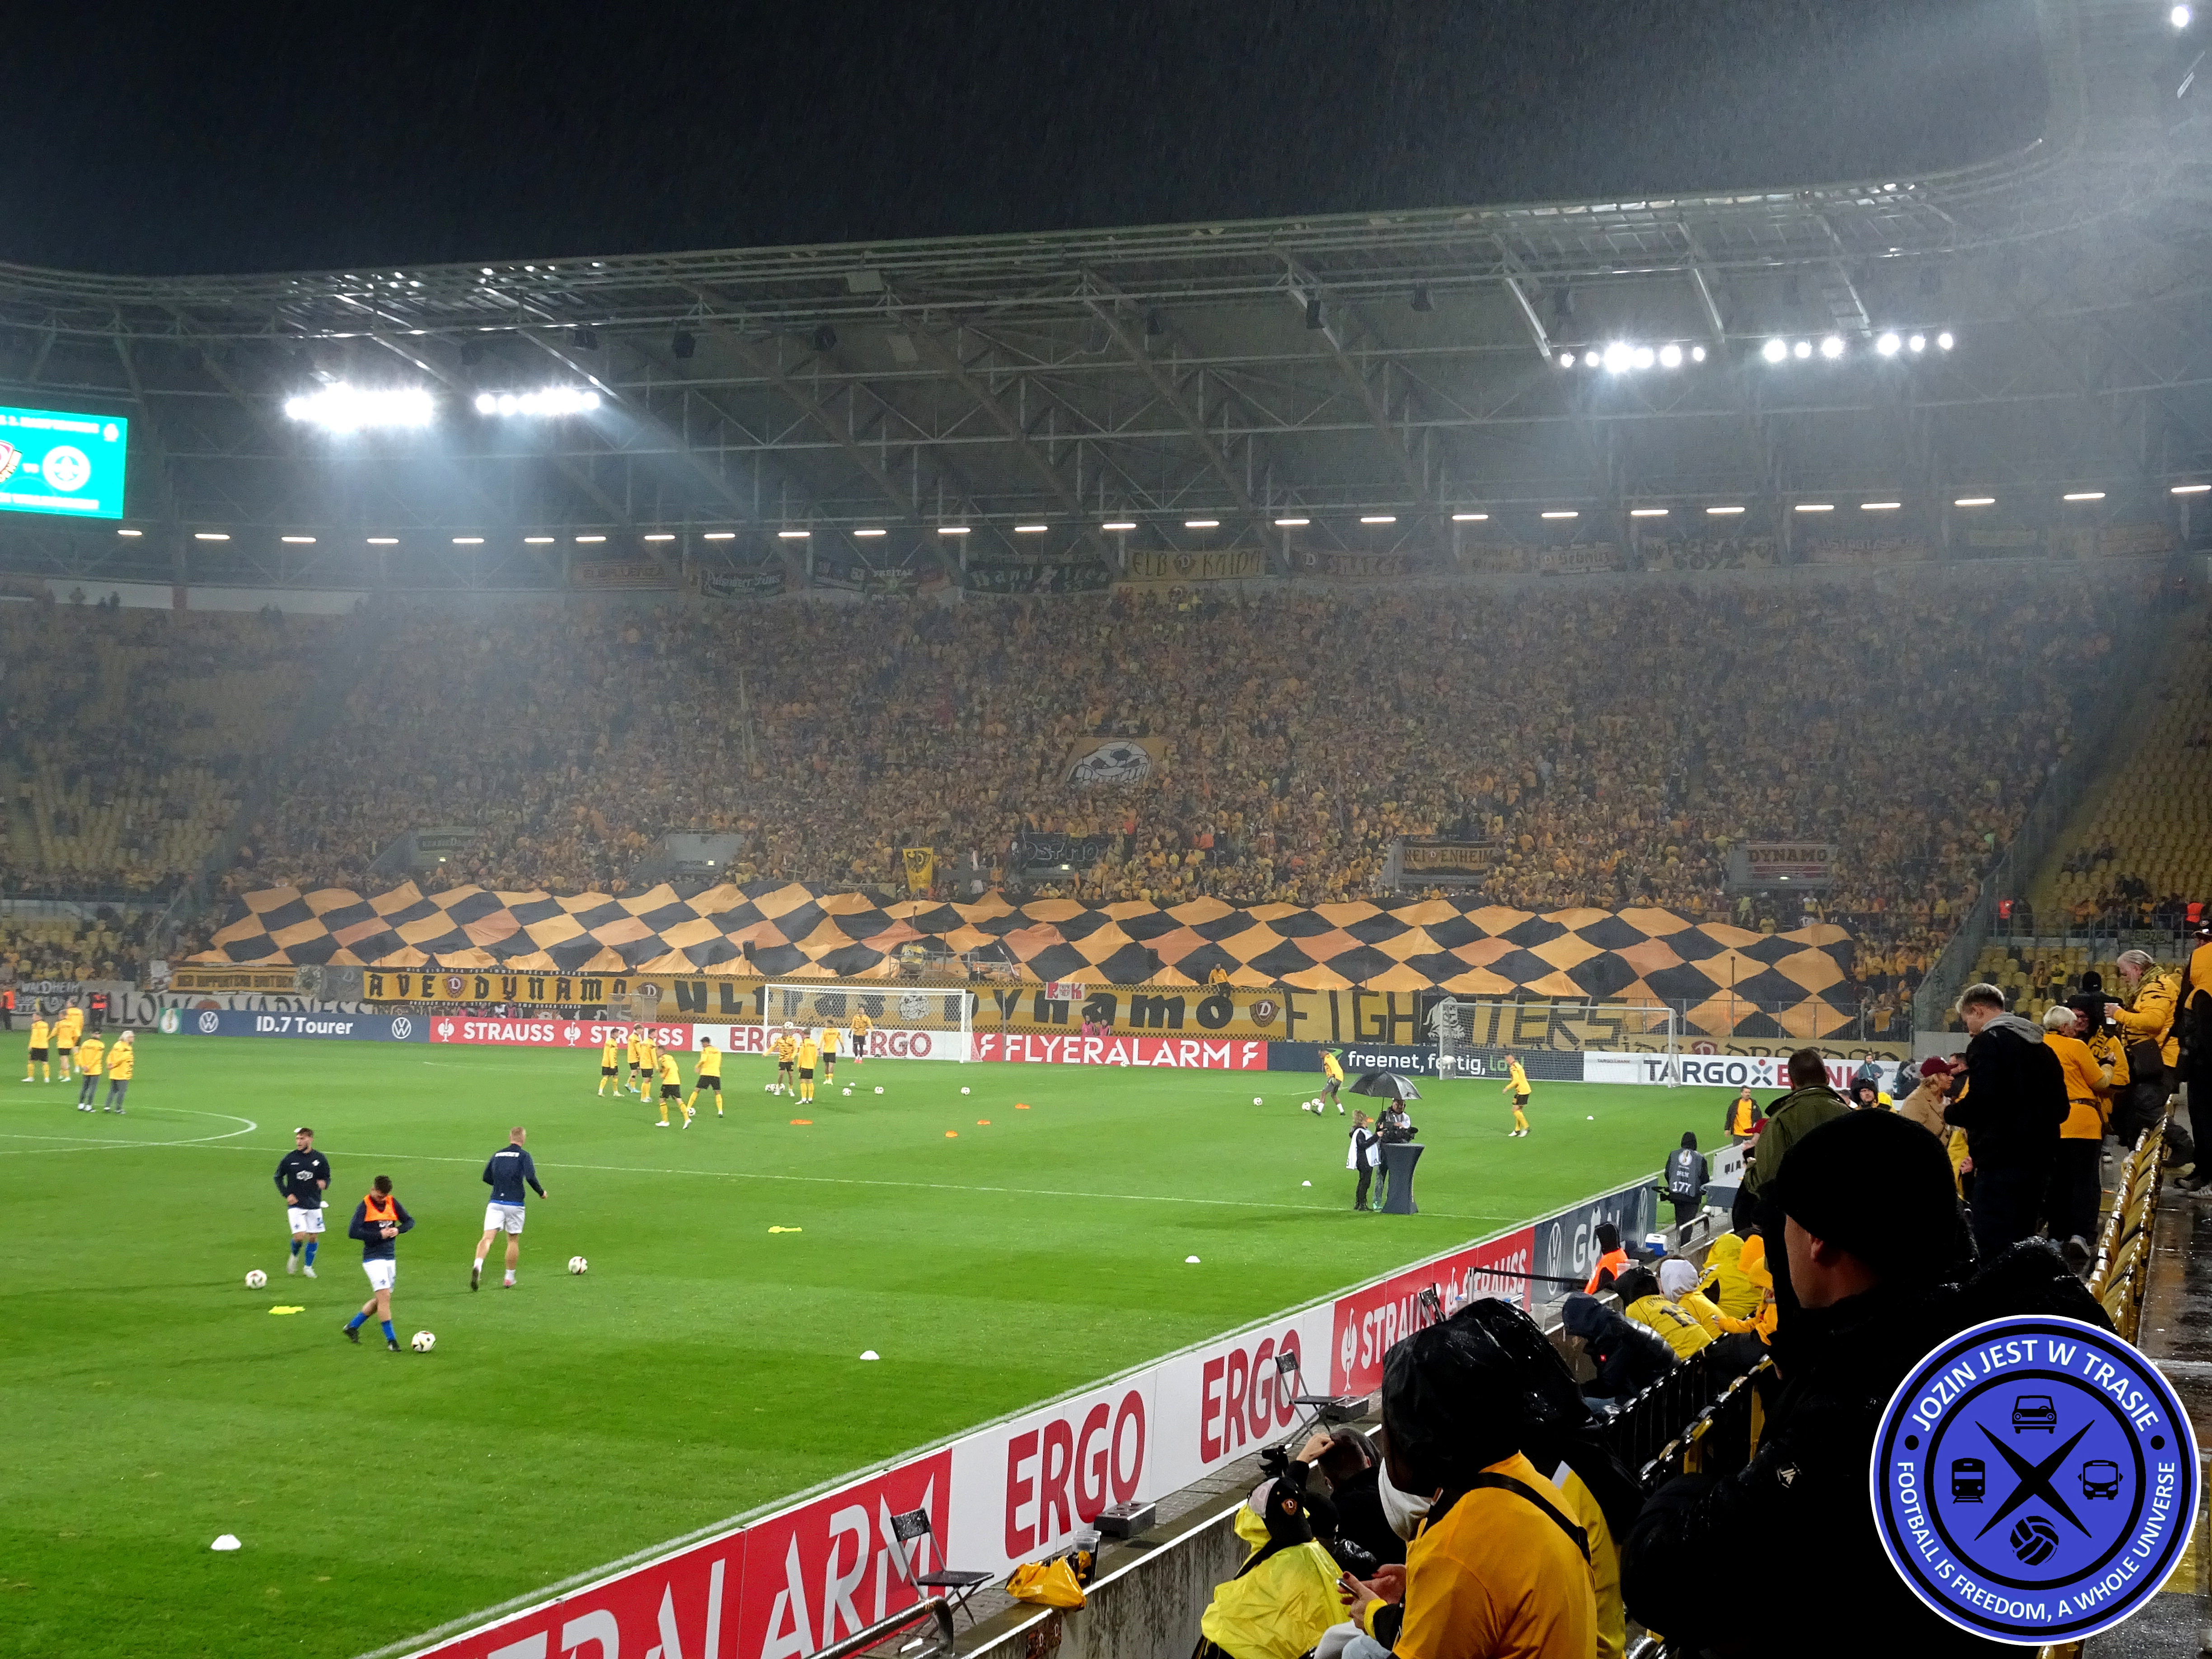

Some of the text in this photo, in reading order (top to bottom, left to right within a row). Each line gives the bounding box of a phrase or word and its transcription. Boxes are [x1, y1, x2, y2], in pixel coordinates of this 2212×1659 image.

[1747, 848, 1828, 862] DYNAMO
[256, 1015, 353, 1035] ID.7 Tourer
[464, 1022, 555, 1043] STRAUSS
[1005, 1034, 1231, 1069] FLYERALARM
[1348, 1050, 1425, 1073] freenet,
[1672, 1181, 1692, 1193] 177
[1200, 1329, 1302, 1464] ERGO
[1005, 1390, 1145, 1560] ERGO
